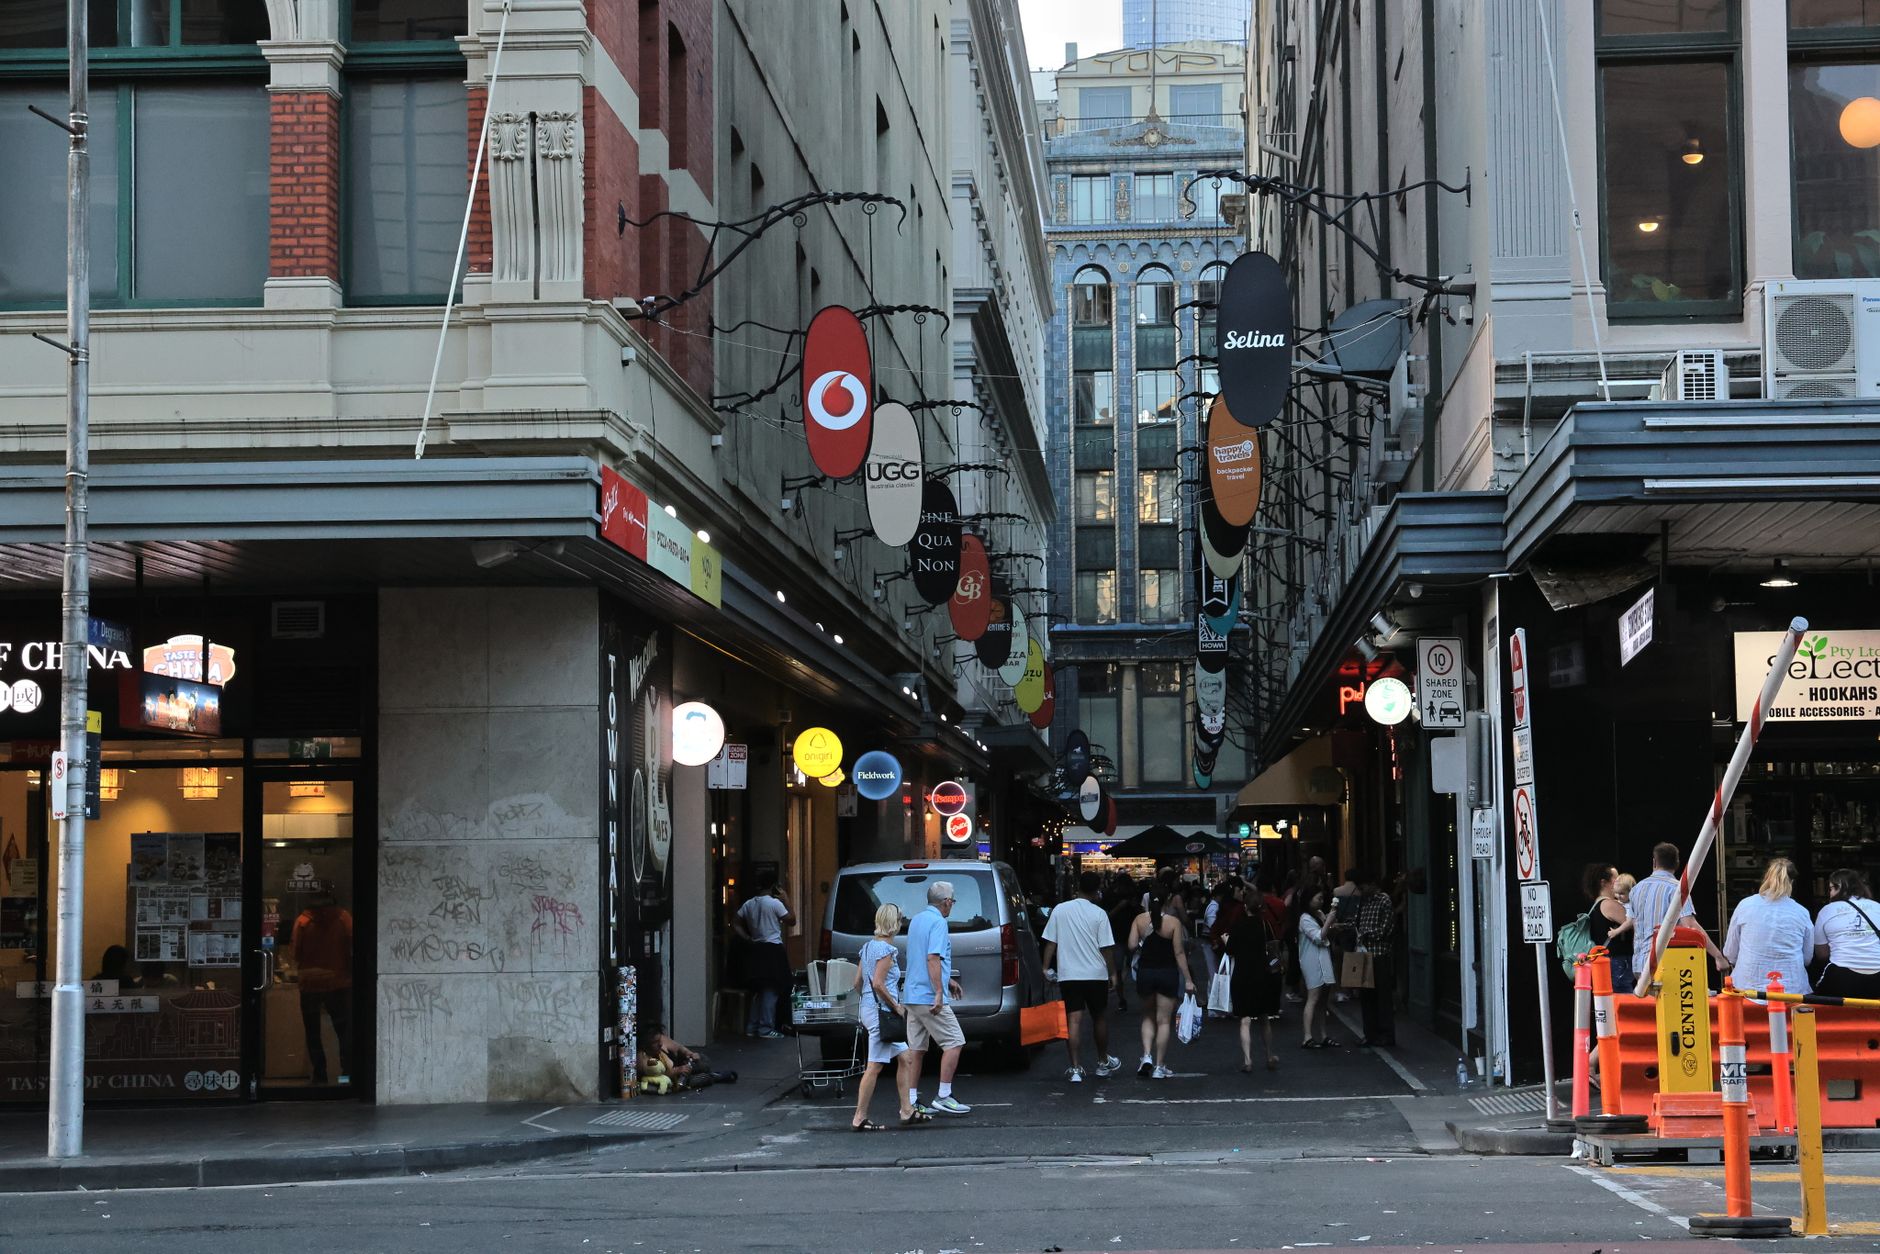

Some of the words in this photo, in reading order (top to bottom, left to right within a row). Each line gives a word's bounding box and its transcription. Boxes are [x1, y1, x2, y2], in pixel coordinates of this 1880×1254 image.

[1224, 330, 1285, 349] Selina
[1215, 443, 1243, 456] happy
[1219, 450, 1250, 461] travels
[866, 461, 919, 481] UGG
[1216, 466, 1253, 475] backpacker
[1227, 472, 1245, 481] travel
[918, 533, 953, 549] QUA
[917, 558, 955, 572] NON
[21, 642, 133, 671] CHNA
[164, 650, 196, 661] TASTE
[1830, 646, 1855, 659] Pty
[1434, 653, 1446, 667] 10
[1425, 678, 1458, 688] SHARED
[1431, 689, 1453, 698] ZONE
[1809, 686, 1878, 701] HOOKAHS
[1767, 707, 1796, 718] OBILE
[1799, 706, 1865, 717] ACCESSORIES
[857, 771, 896, 780] Fieldwork
[1527, 888, 1537, 901] NO
[1523, 905, 1546, 920] THROUGH
[1527, 923, 1544, 937] ROAD
[1680, 967, 1693, 1050] CENTSYS
[108, 1074, 176, 1089] CHINA
